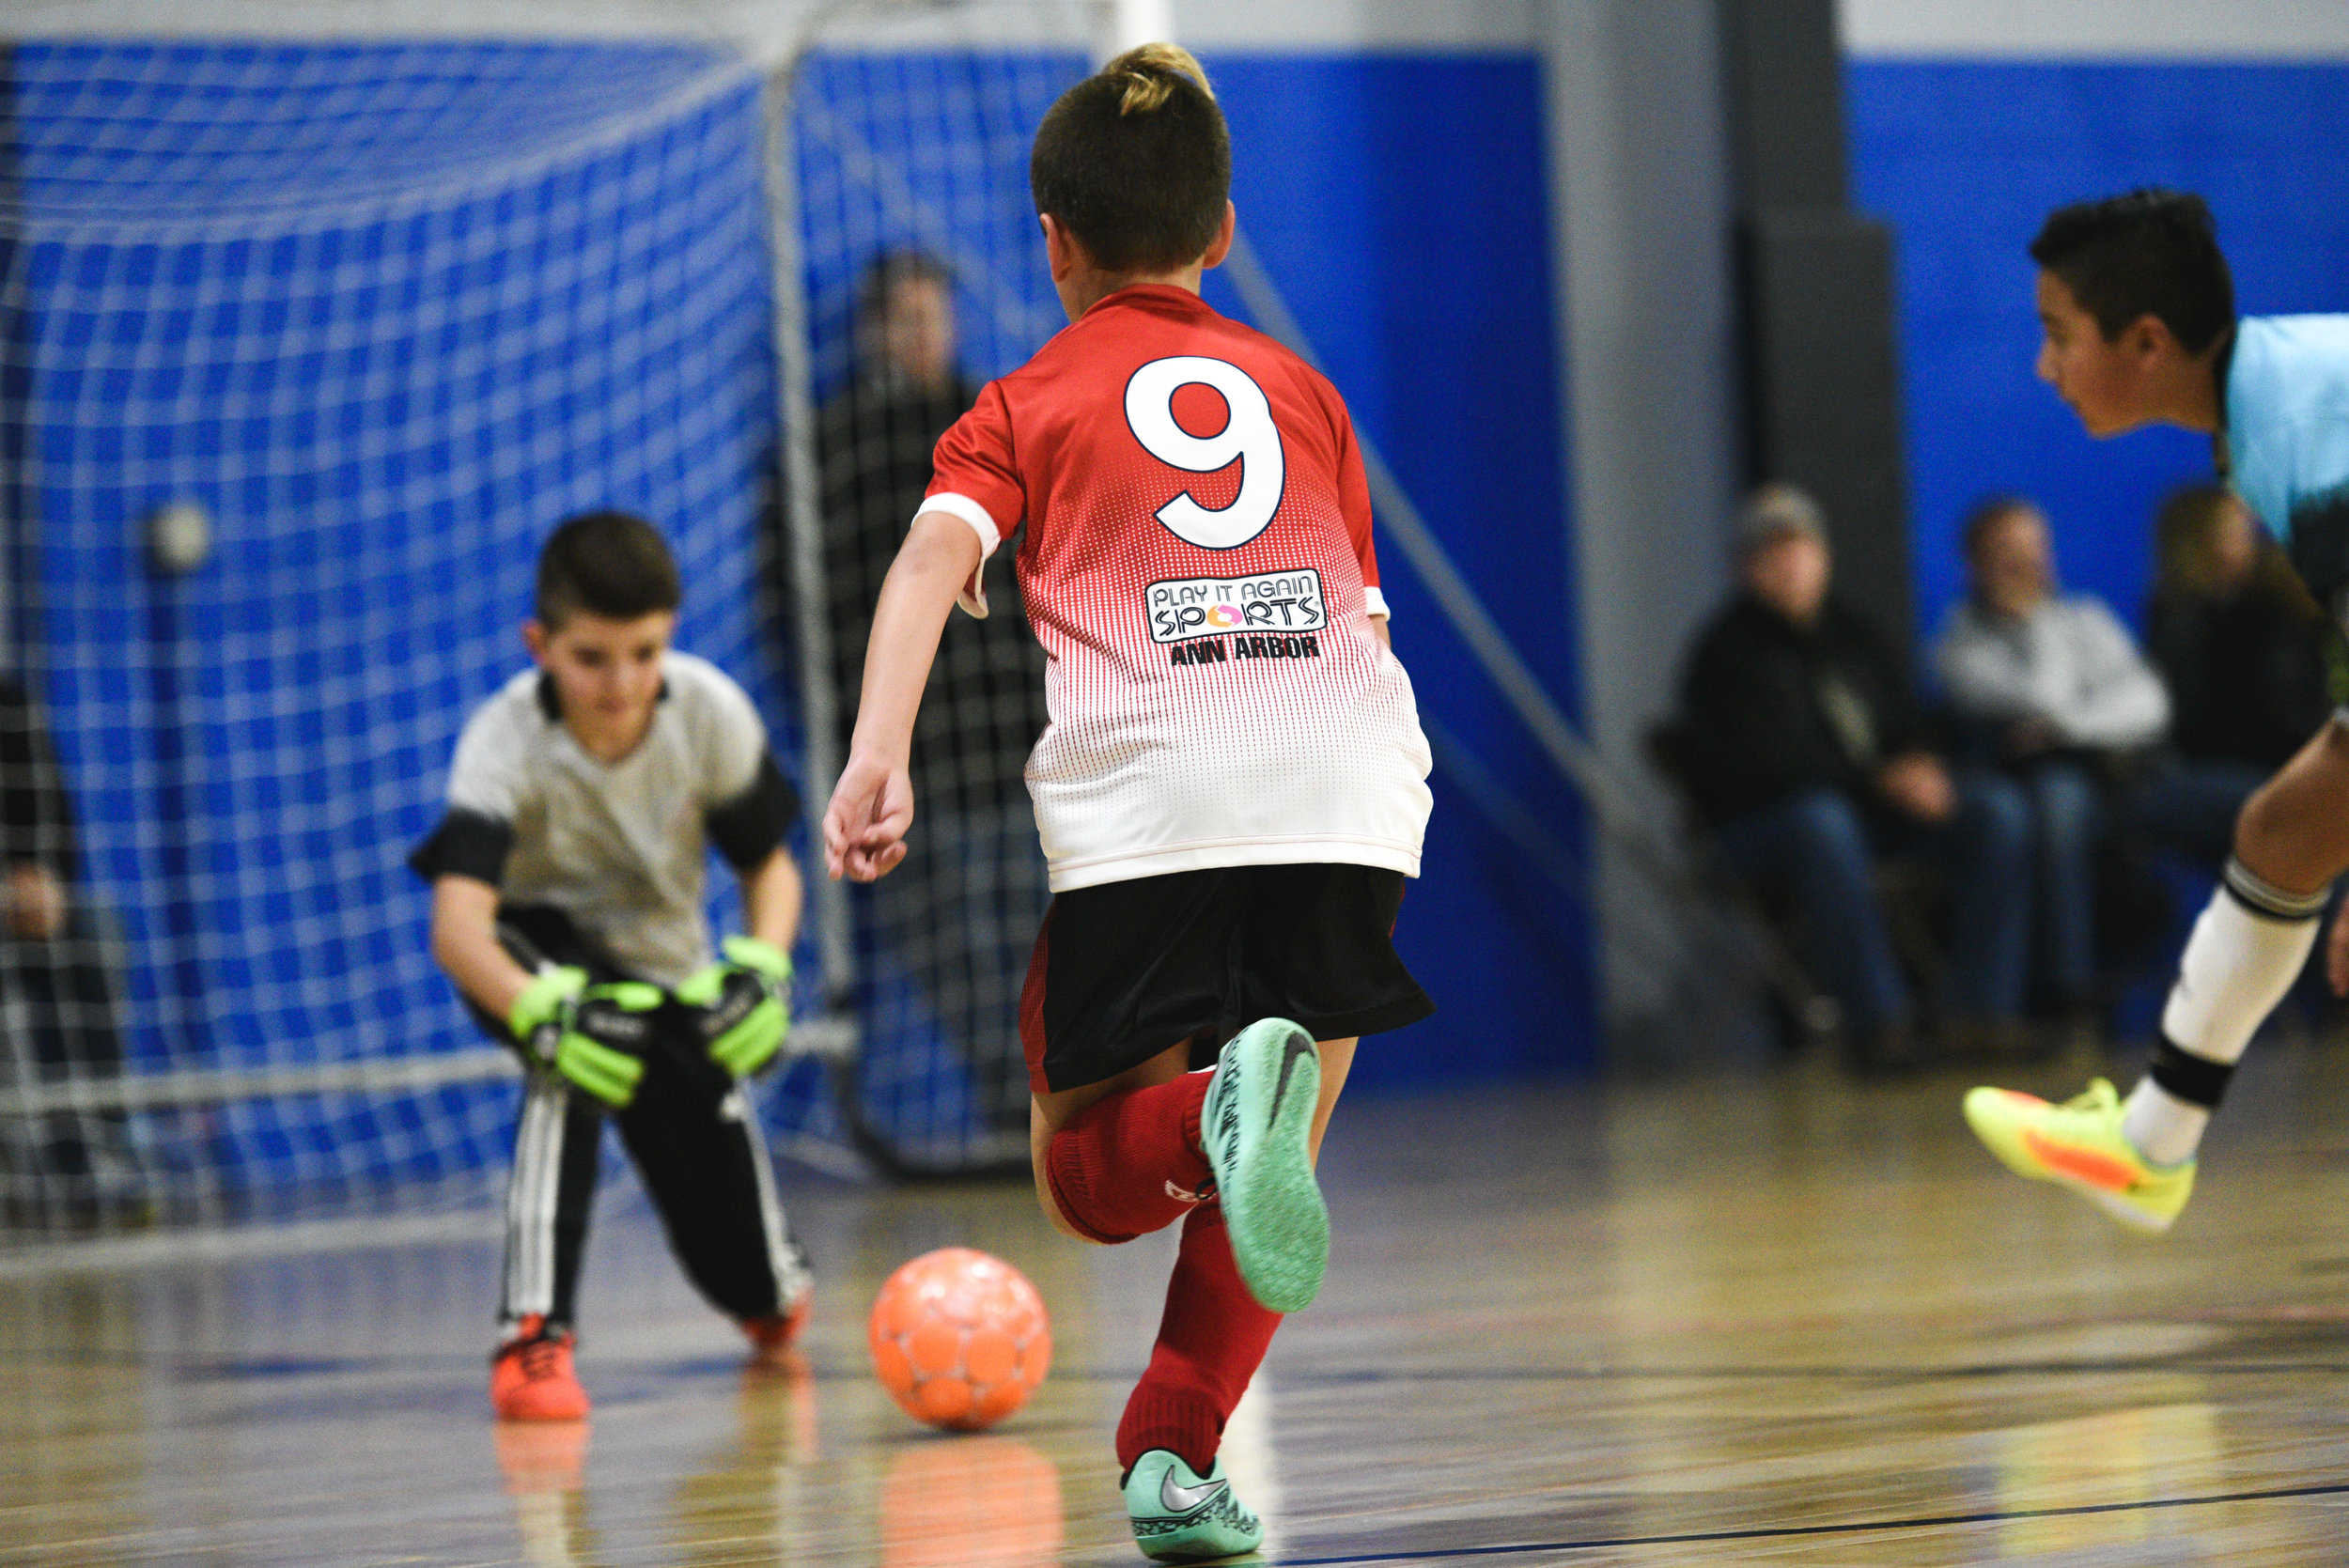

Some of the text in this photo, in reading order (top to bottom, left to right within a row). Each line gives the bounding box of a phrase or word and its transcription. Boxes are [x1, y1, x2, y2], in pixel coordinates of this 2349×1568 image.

[1124, 355, 1285, 551] 9
[1153, 576, 1313, 607] PLAY IT AGAIN
[1155, 597, 1319, 636] SPORTS
[1171, 636, 1320, 666] ANN ARBOR
